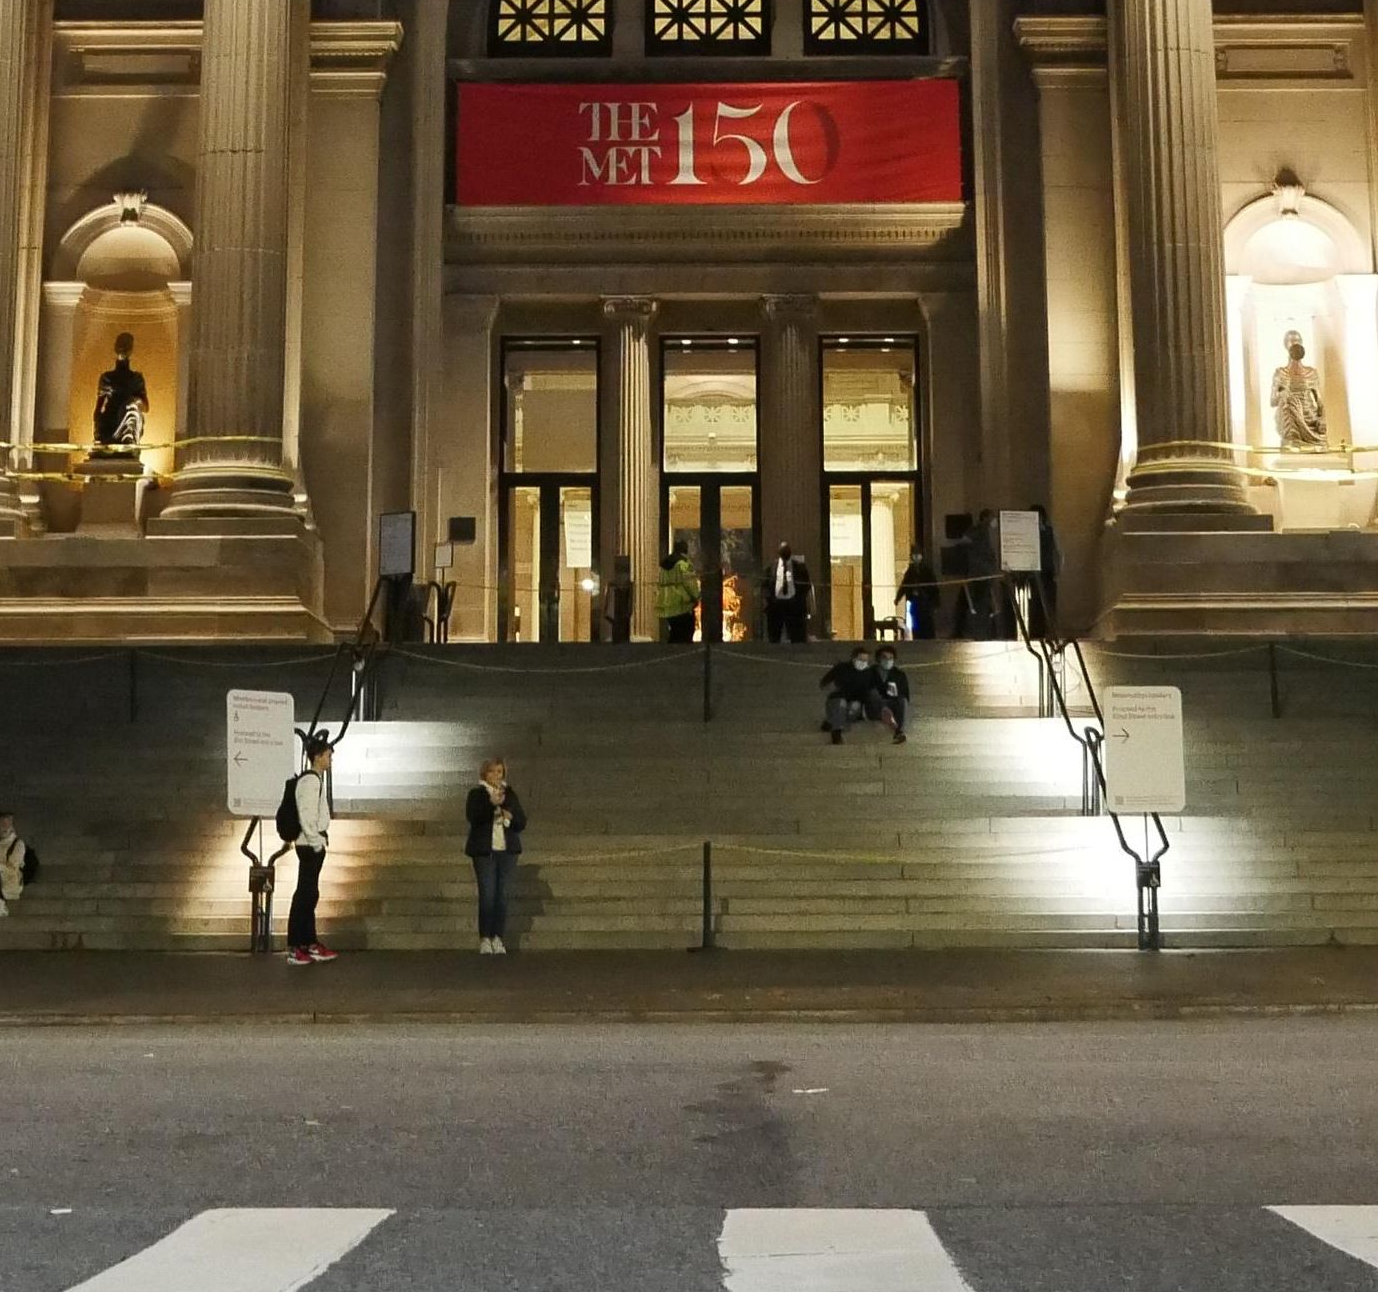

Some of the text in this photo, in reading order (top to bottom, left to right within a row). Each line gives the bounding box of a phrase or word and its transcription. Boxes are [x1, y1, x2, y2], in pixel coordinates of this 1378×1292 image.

[578, 102, 661, 142] THE
[666, 101, 841, 186] 150
[576, 146, 662, 186] MET
